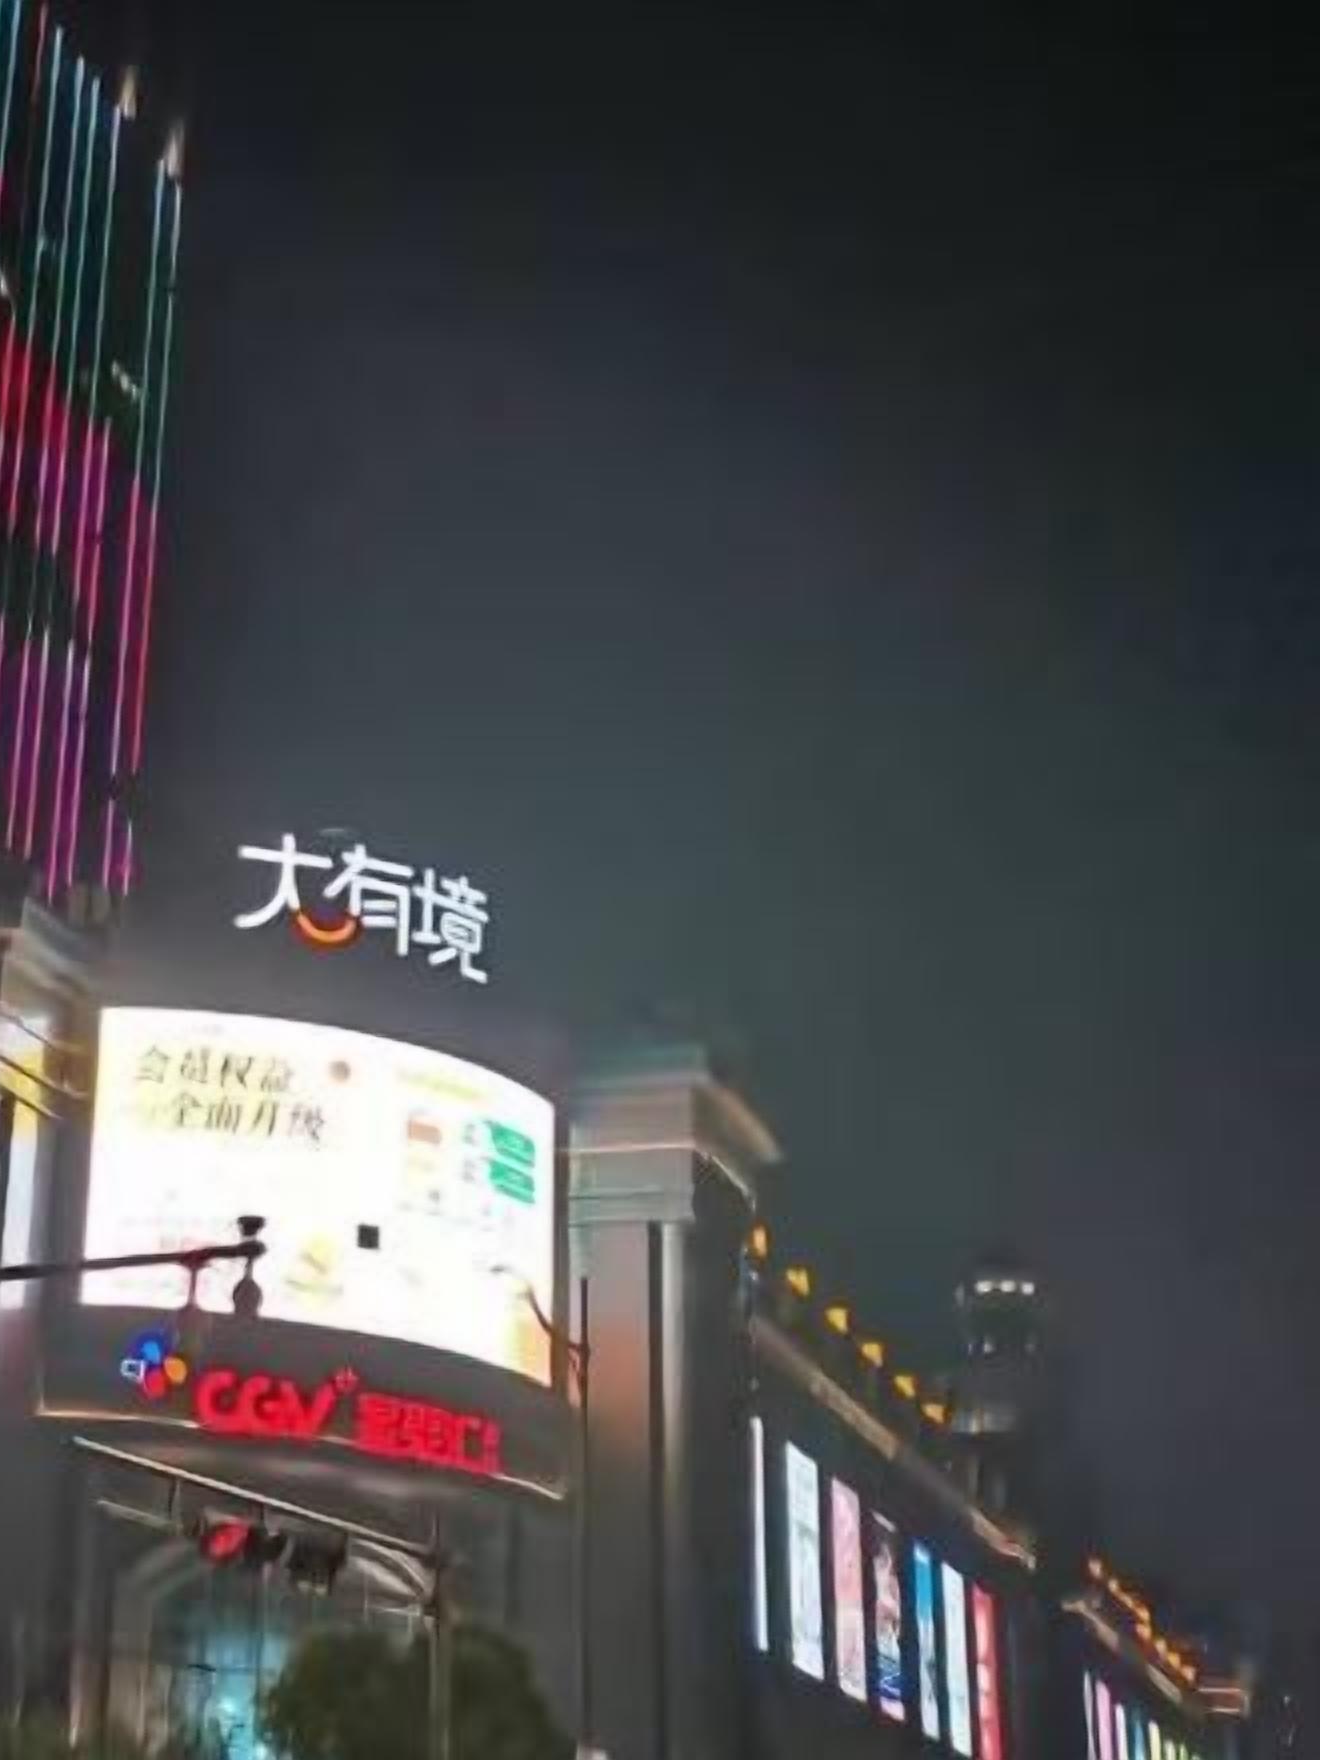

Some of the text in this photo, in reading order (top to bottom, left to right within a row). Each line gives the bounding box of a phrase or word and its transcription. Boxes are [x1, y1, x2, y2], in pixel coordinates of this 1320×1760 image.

[234, 832, 489, 984] 大有境
[135, 1044, 294, 1092] 会员权益
[194, 1367, 340, 1440] CGV
